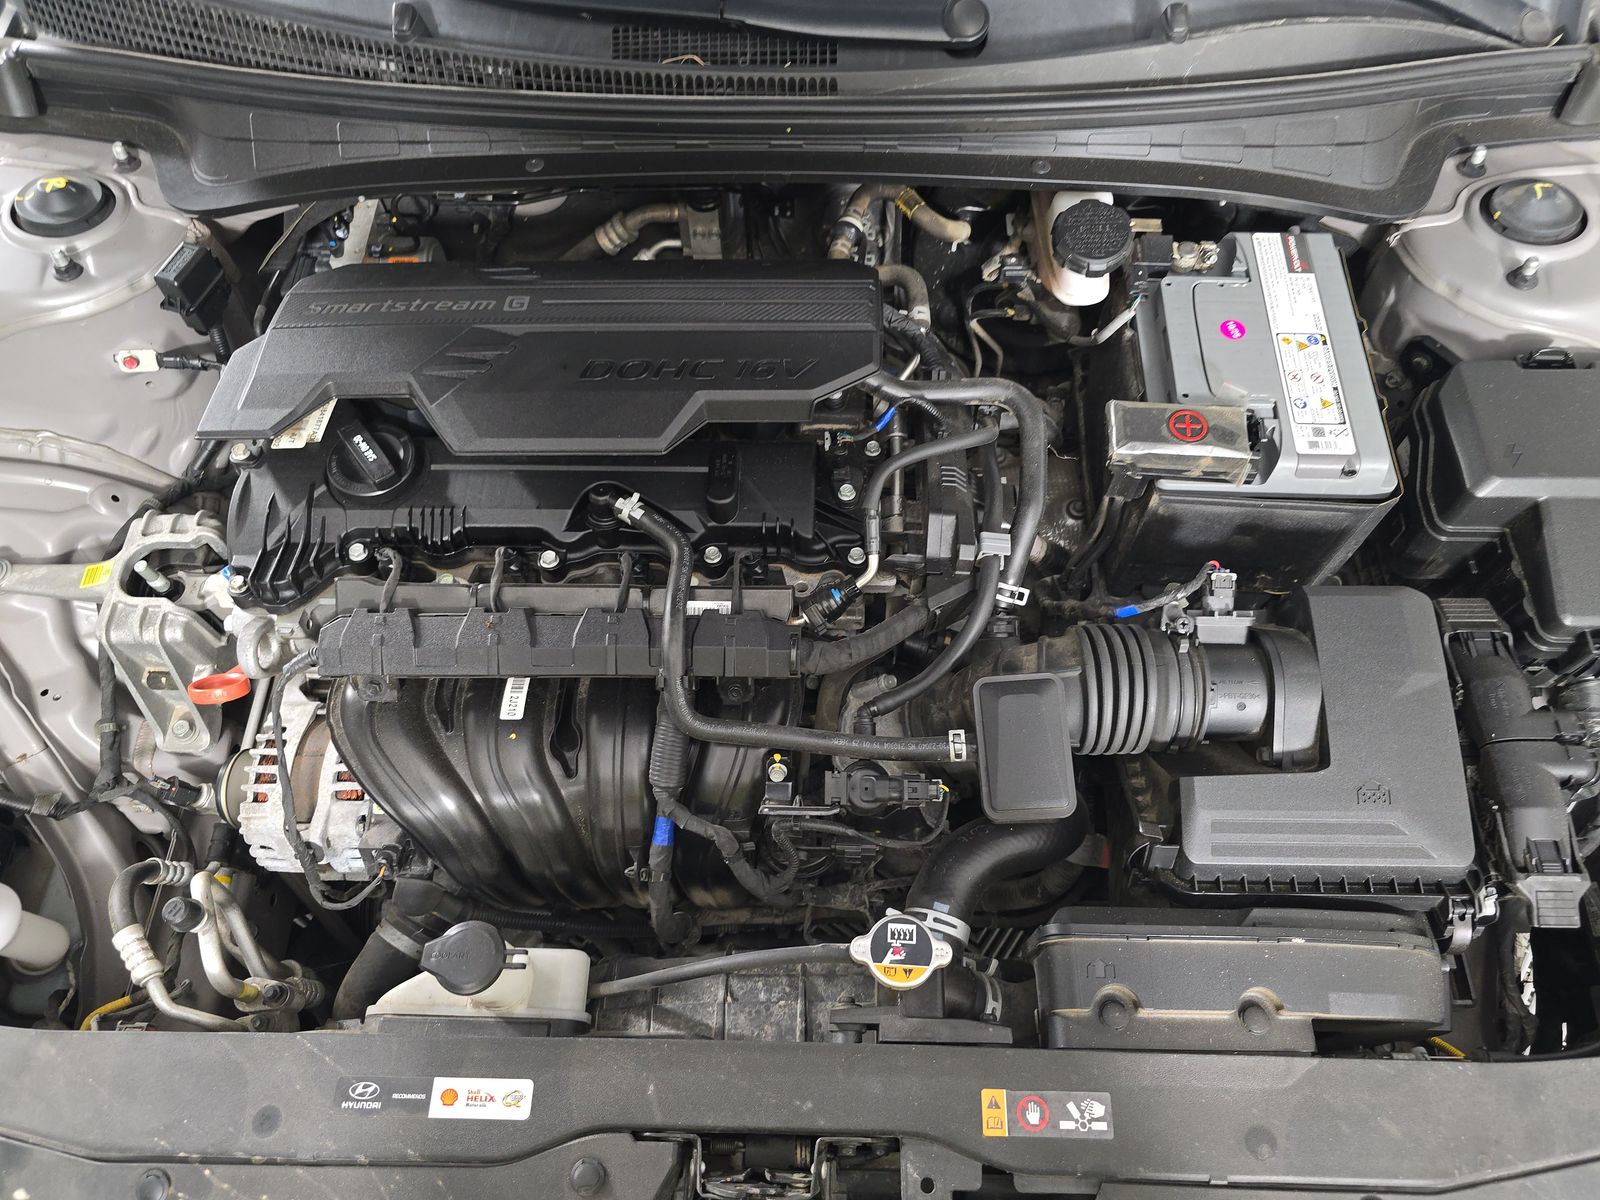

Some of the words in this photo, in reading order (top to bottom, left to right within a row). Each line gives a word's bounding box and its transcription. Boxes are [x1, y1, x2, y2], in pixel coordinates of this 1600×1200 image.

[578, 358, 725, 381] DOHC
[735, 358, 819, 381] 16V
[466, 1094, 496, 1103] HELIX
[341, 1101, 382, 1110] HYUNDAI
